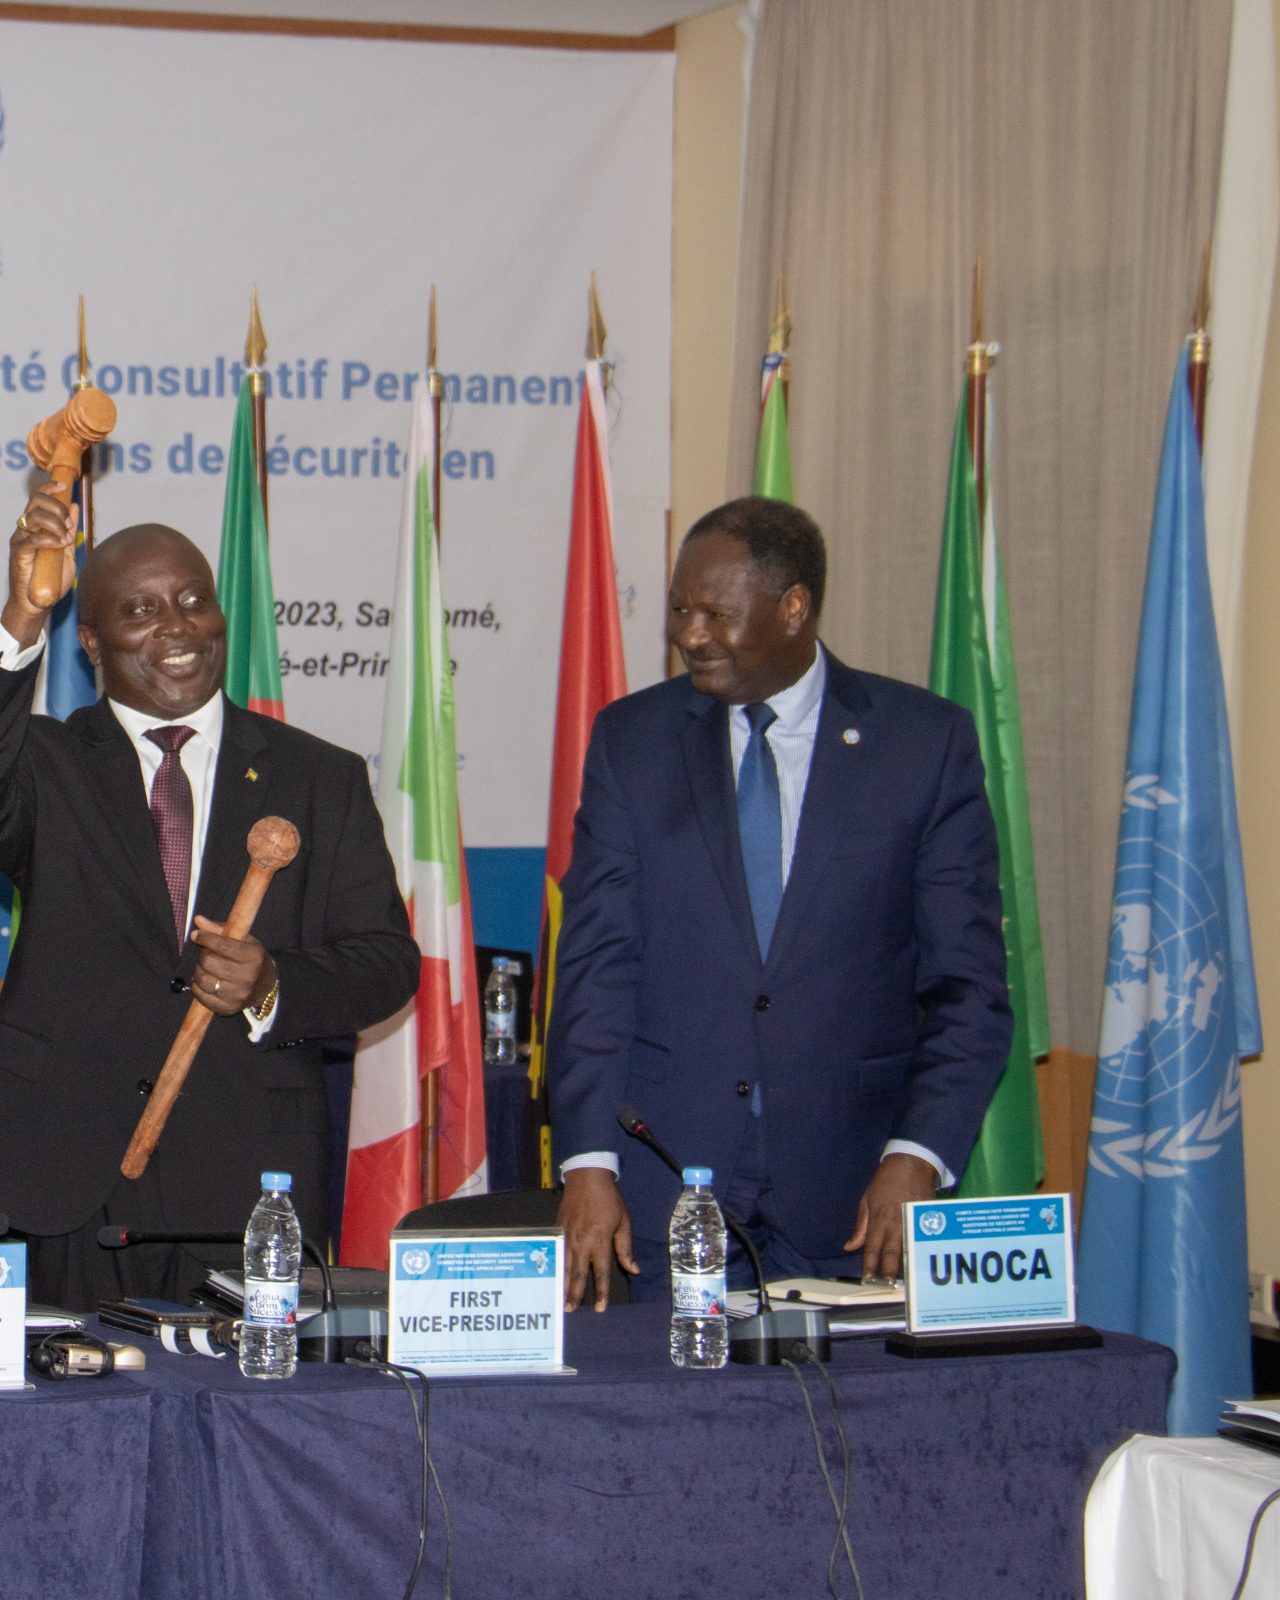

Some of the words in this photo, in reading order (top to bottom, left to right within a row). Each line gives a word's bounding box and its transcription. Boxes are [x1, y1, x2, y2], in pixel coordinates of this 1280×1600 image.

[61, 353, 328, 402] Consulttif
[167, 433, 224, 475] de
[266, 434, 408, 479] écurit
[442, 448, 495, 480] en
[274, 601, 343, 631] 2023,
[929, 1248, 1052, 1286] UNOCA
[449, 1290, 502, 1308] FIRST
[399, 1313, 551, 1333] VICE-PRESIDENT
